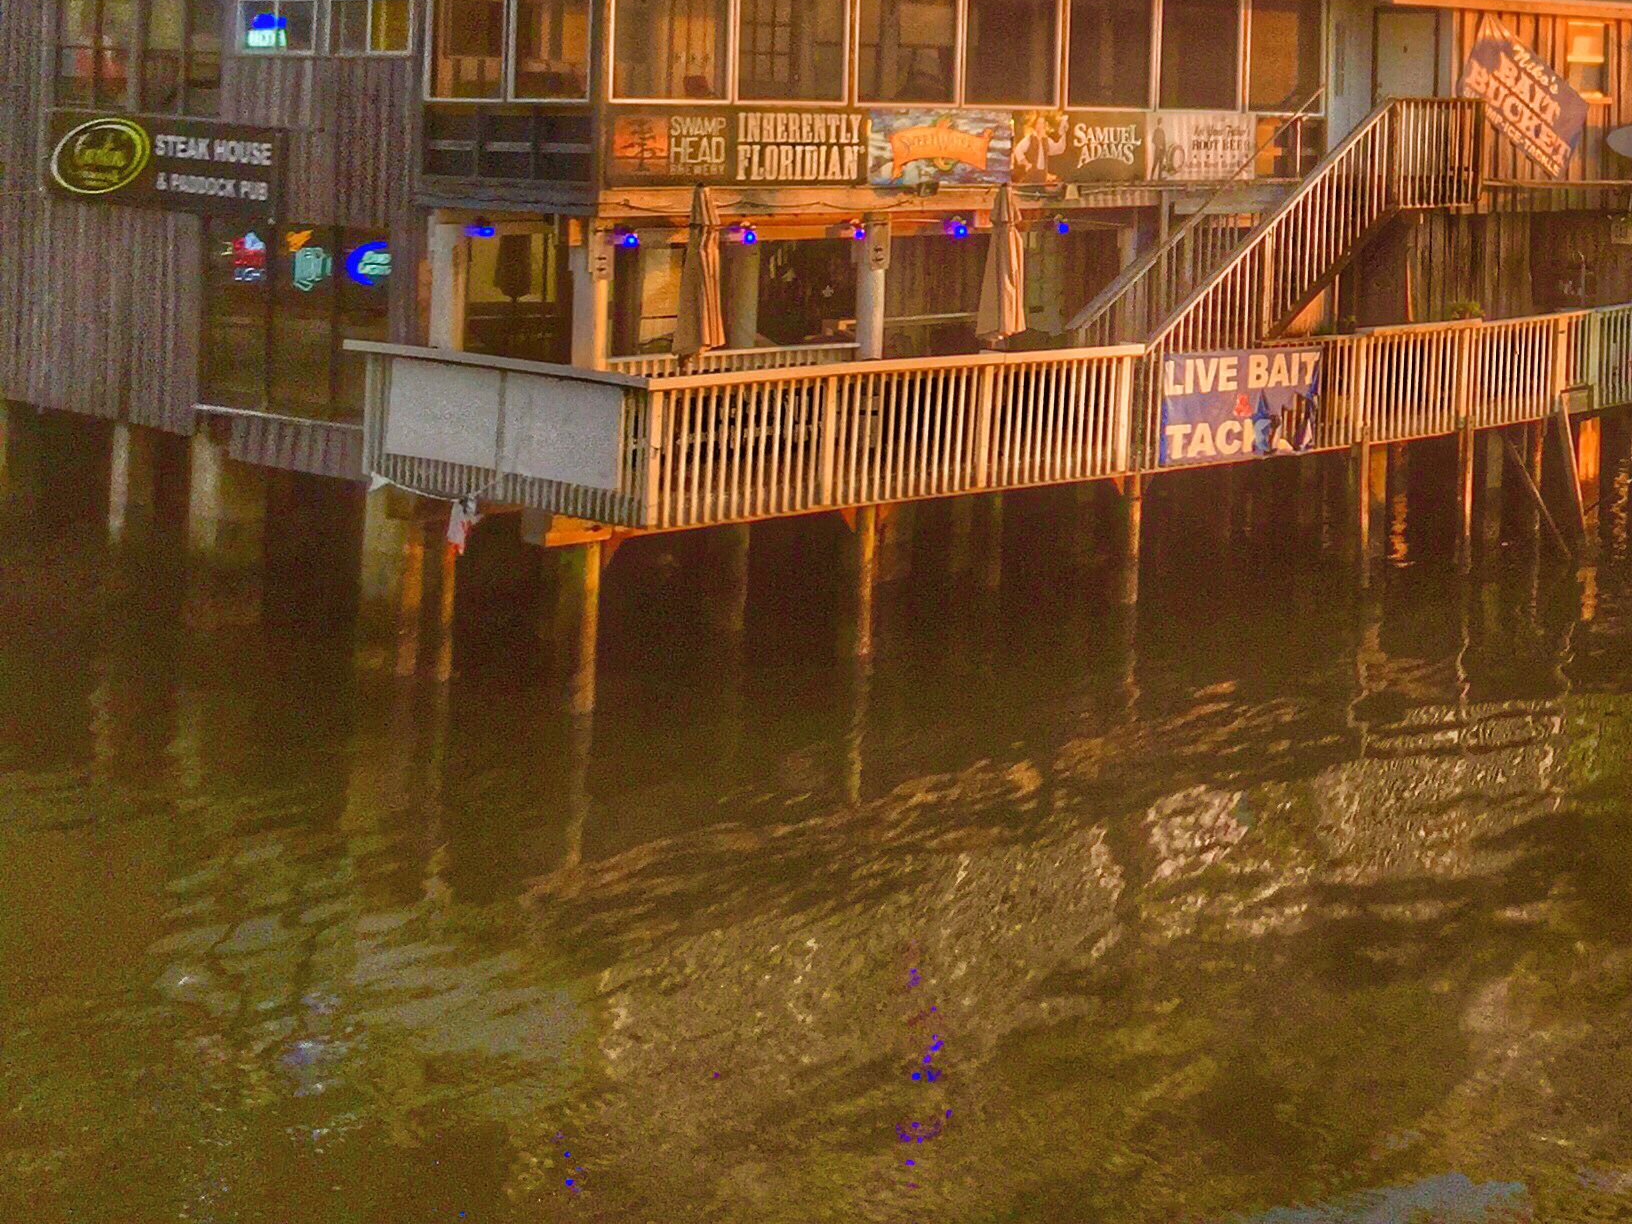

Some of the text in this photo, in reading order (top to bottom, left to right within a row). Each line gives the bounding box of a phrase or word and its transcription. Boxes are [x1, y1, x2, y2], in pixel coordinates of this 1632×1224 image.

[1491, 51, 1561, 127] BAIT
[669, 115, 727, 136] SWAMP
[736, 112, 863, 143] INHERENTLY
[1464, 57, 1572, 168] BUCKET
[156, 134, 210, 160] STEAK
[213, 138, 272, 165] HOUSE
[670, 136, 726, 164] HEAD
[1073, 123, 1142, 148] SAMUEL
[736, 144, 860, 181] FLORIDIAN
[1077, 142, 1135, 169] ADAMS
[156, 172, 269, 201] & PADDOCK PUB
[1164, 351, 1321, 396] LIVE BAIT
